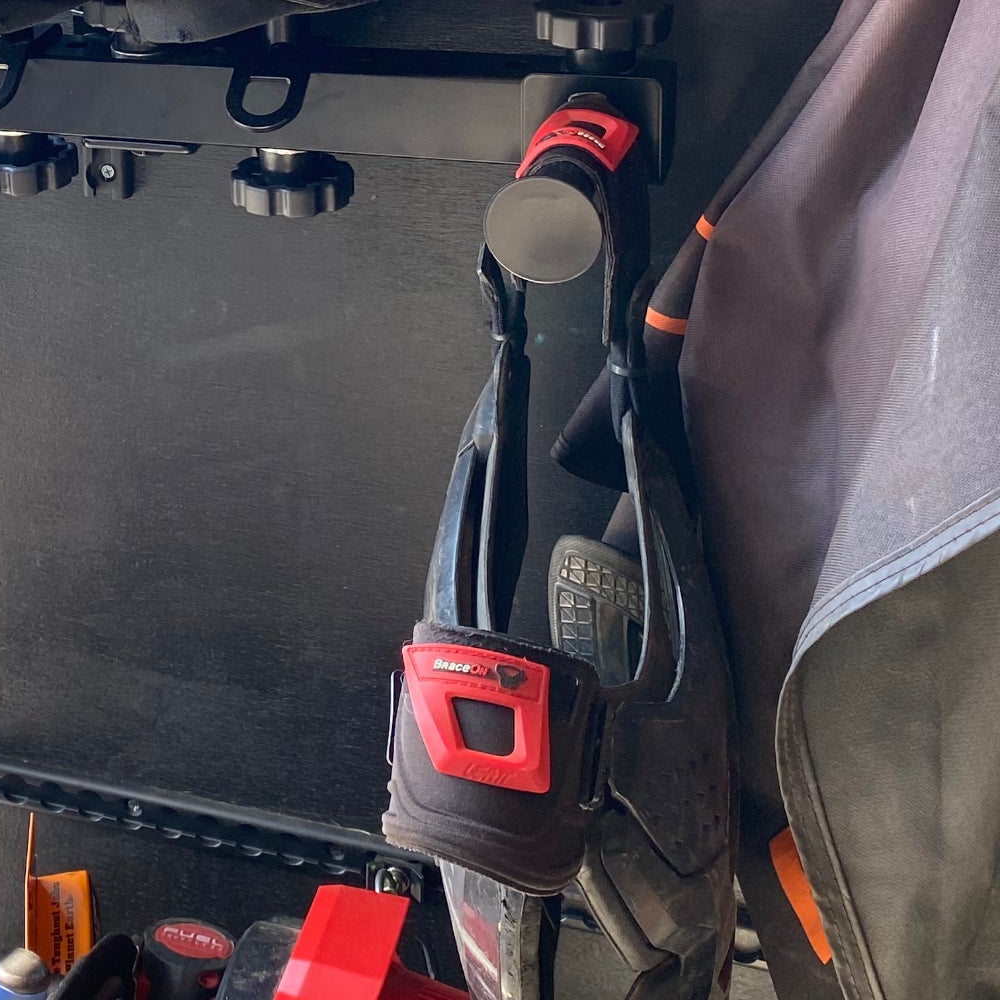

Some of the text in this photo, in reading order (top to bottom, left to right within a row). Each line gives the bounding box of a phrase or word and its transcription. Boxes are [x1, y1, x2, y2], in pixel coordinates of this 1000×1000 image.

[50, 911, 63, 966] Toughest
[65, 932, 75, 973] Planet
[163, 926, 224, 949] FUEL
